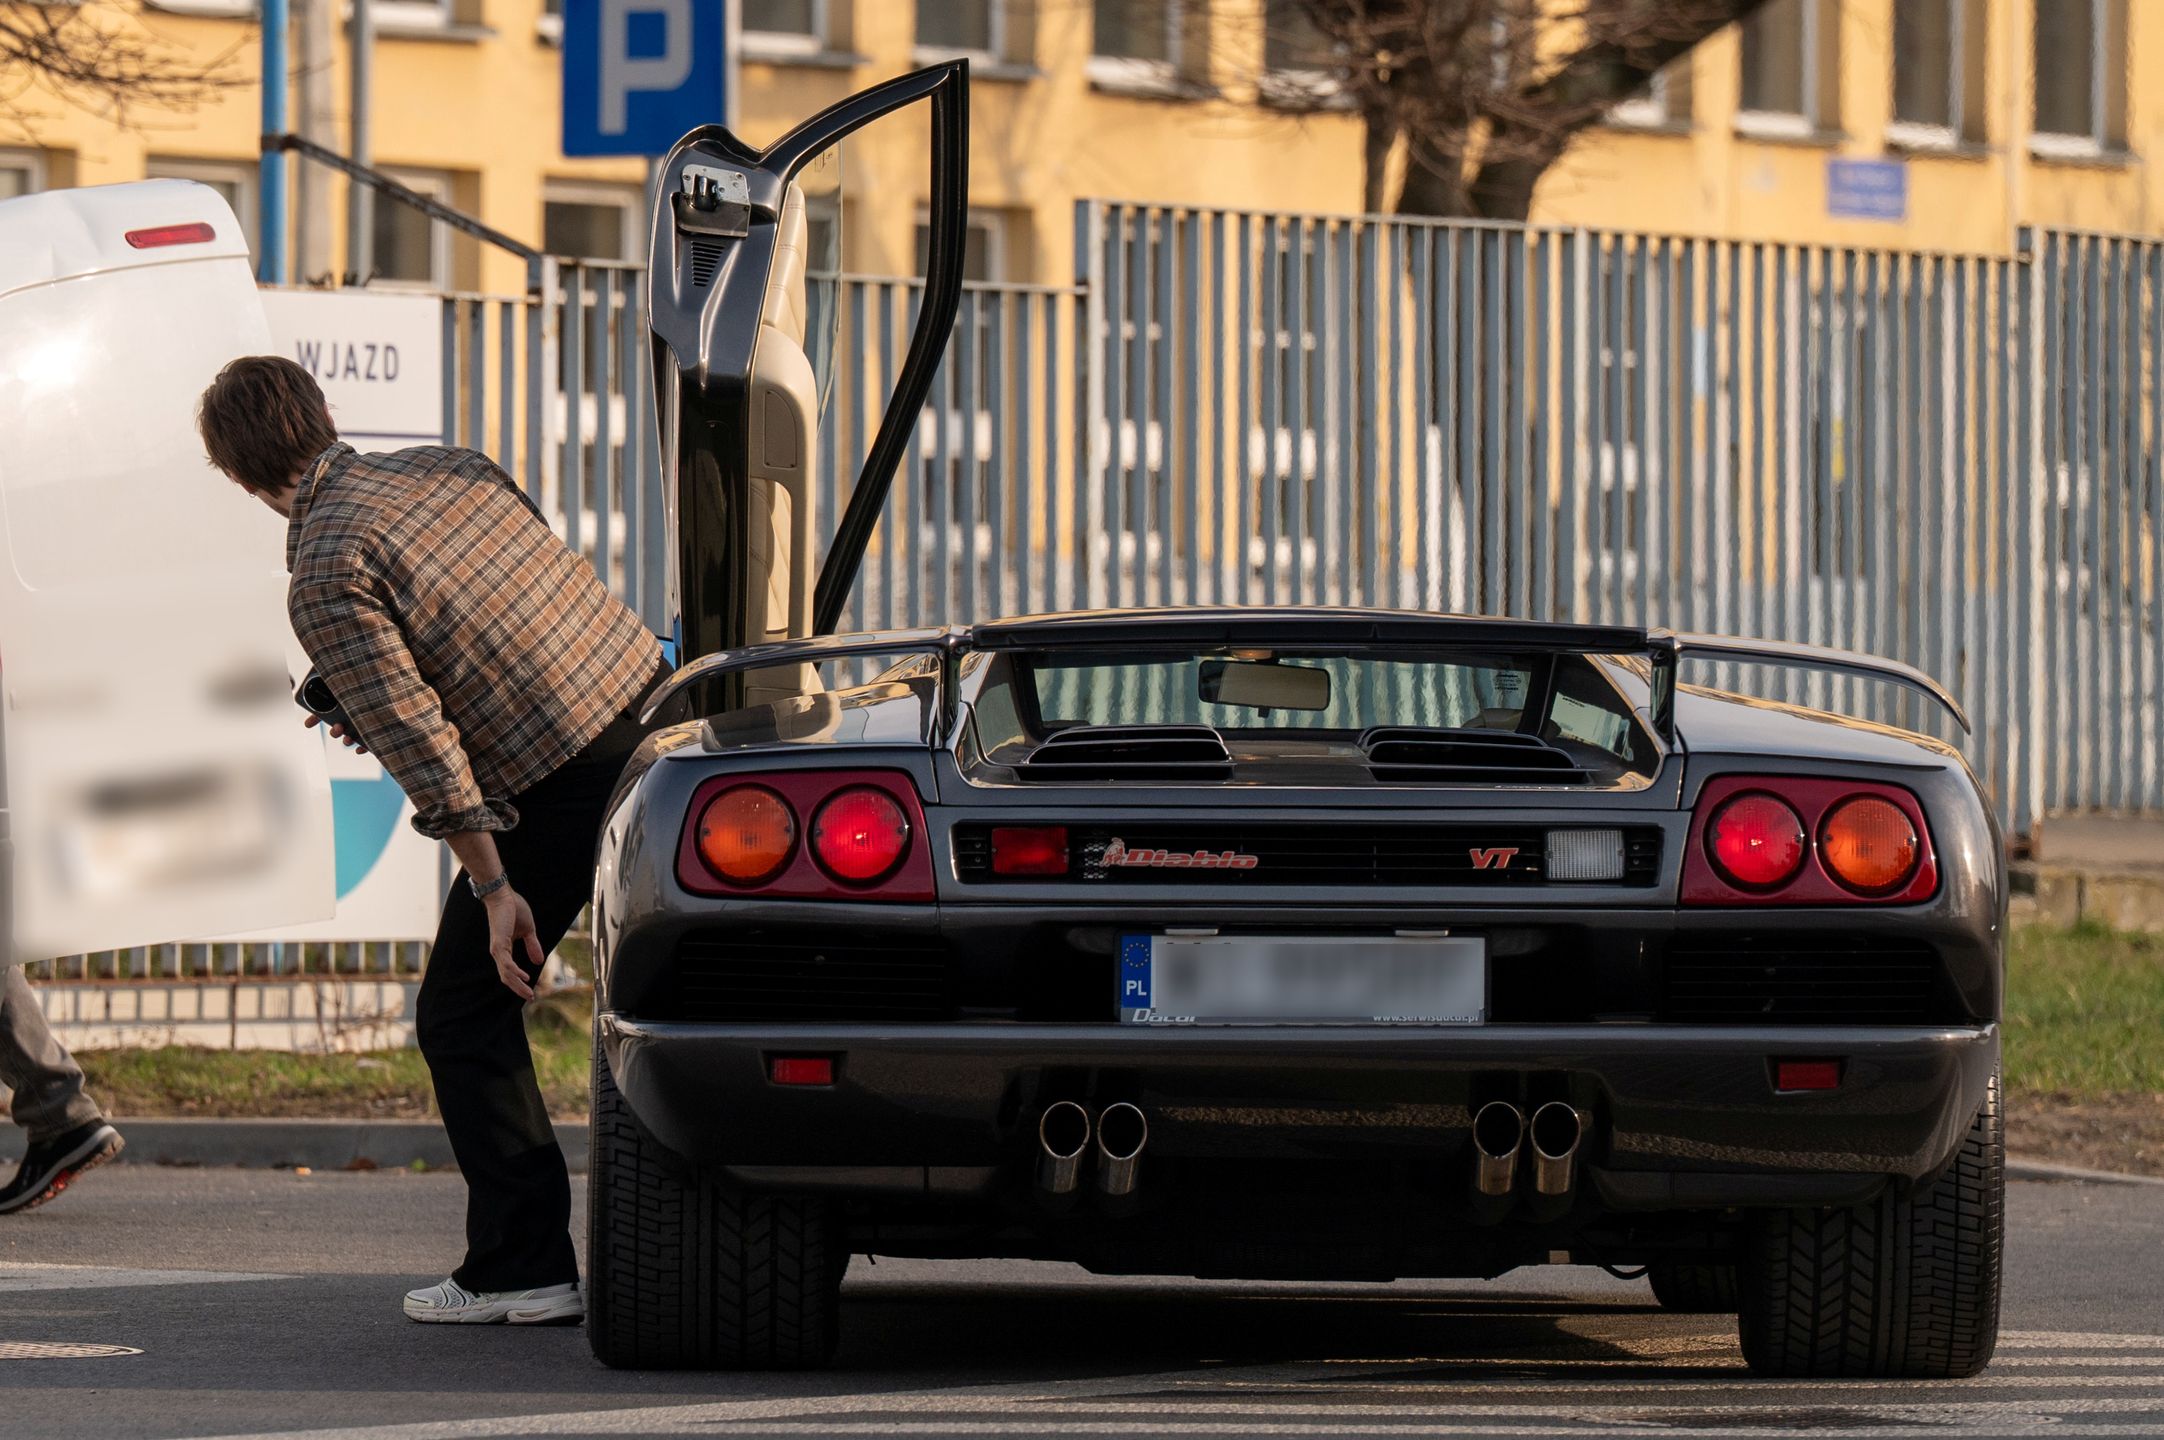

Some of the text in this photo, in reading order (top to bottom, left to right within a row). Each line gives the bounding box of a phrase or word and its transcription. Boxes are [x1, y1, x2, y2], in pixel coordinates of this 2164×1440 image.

[599, 0, 693, 135] P
[296, 340, 399, 382] WJAZD
[1123, 849, 1258, 869] Diablo
[1469, 848, 1519, 869] VT
[1126, 980, 1147, 996] PL
